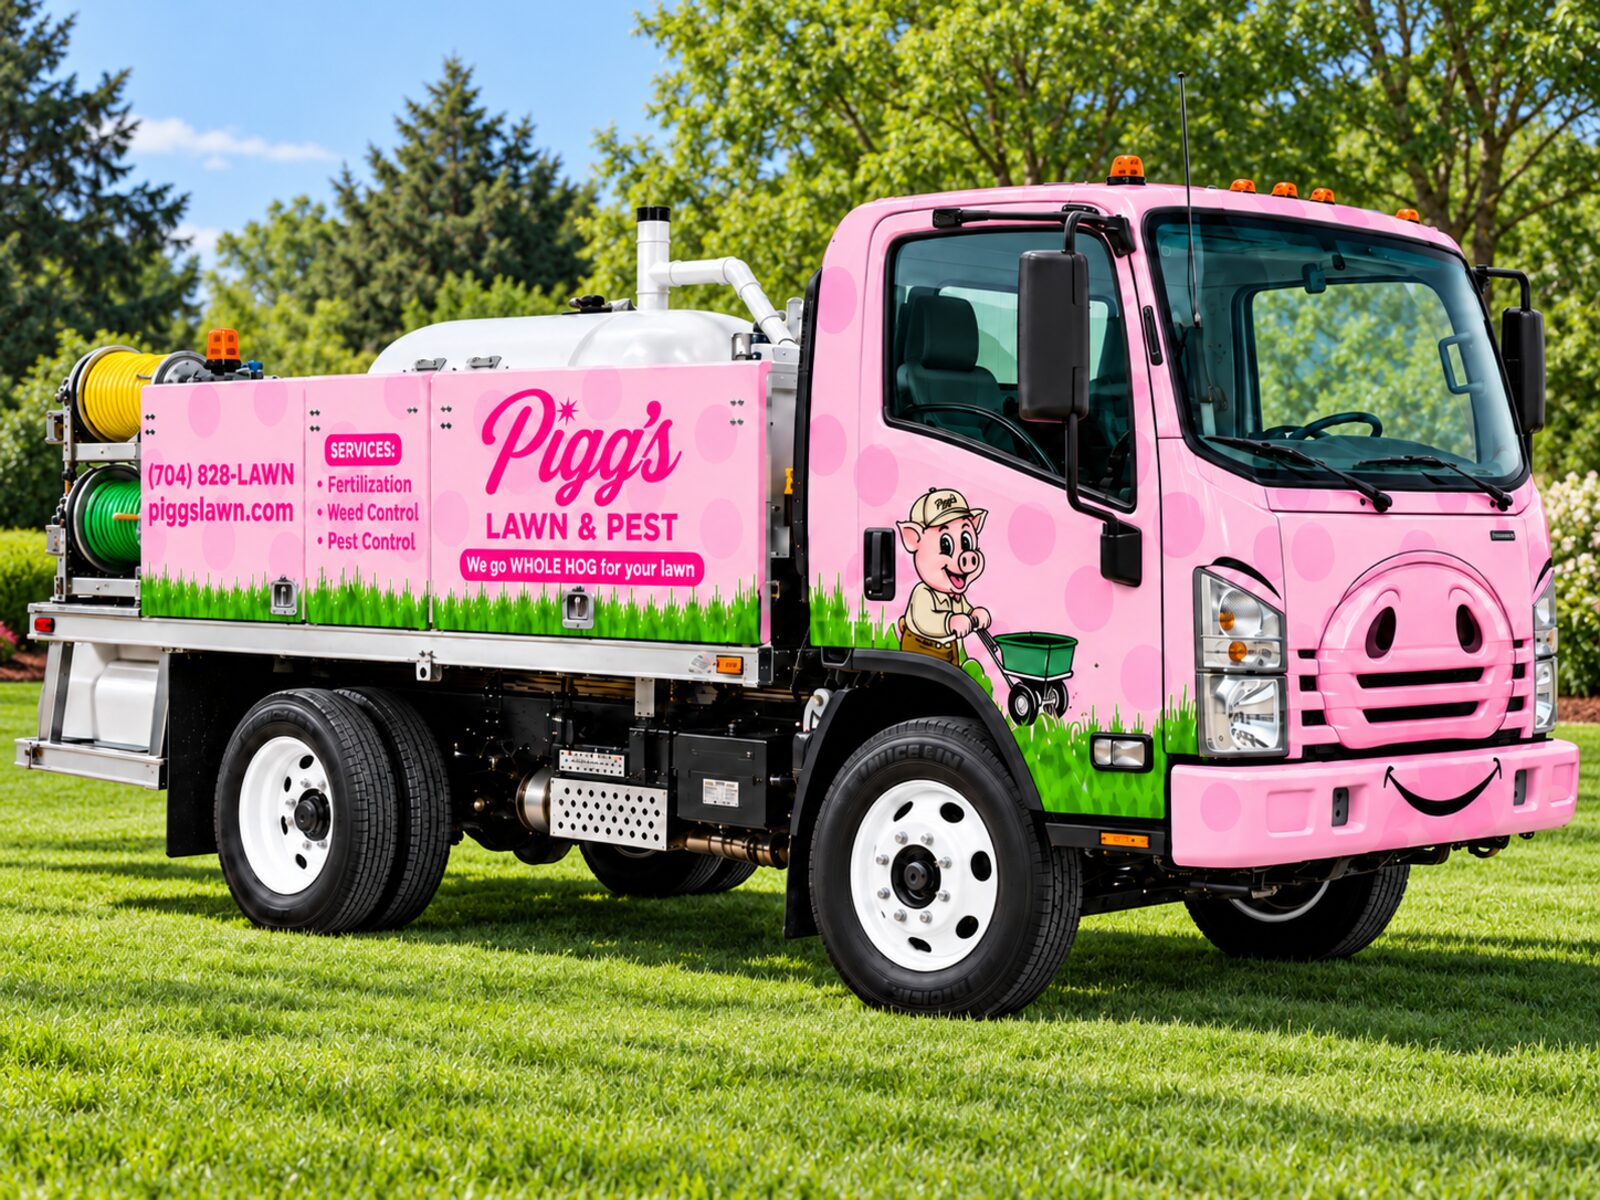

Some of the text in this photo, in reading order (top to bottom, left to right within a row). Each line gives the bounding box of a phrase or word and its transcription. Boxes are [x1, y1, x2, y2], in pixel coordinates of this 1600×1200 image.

[331, 441, 395, 459] SERVICES:
[482, 388, 682, 506] Pigg's
[149, 463, 294, 489] (704) 828-LAWN
[328, 475, 412, 493] Fertilization
[149, 496, 294, 527] piggslawn.com
[328, 503, 419, 521] Weed Control
[486, 513, 678, 541] LAWN & PEST
[328, 532, 416, 550] Pest Control
[466, 556, 695, 579] We go WHOLE HOG for your lawn
